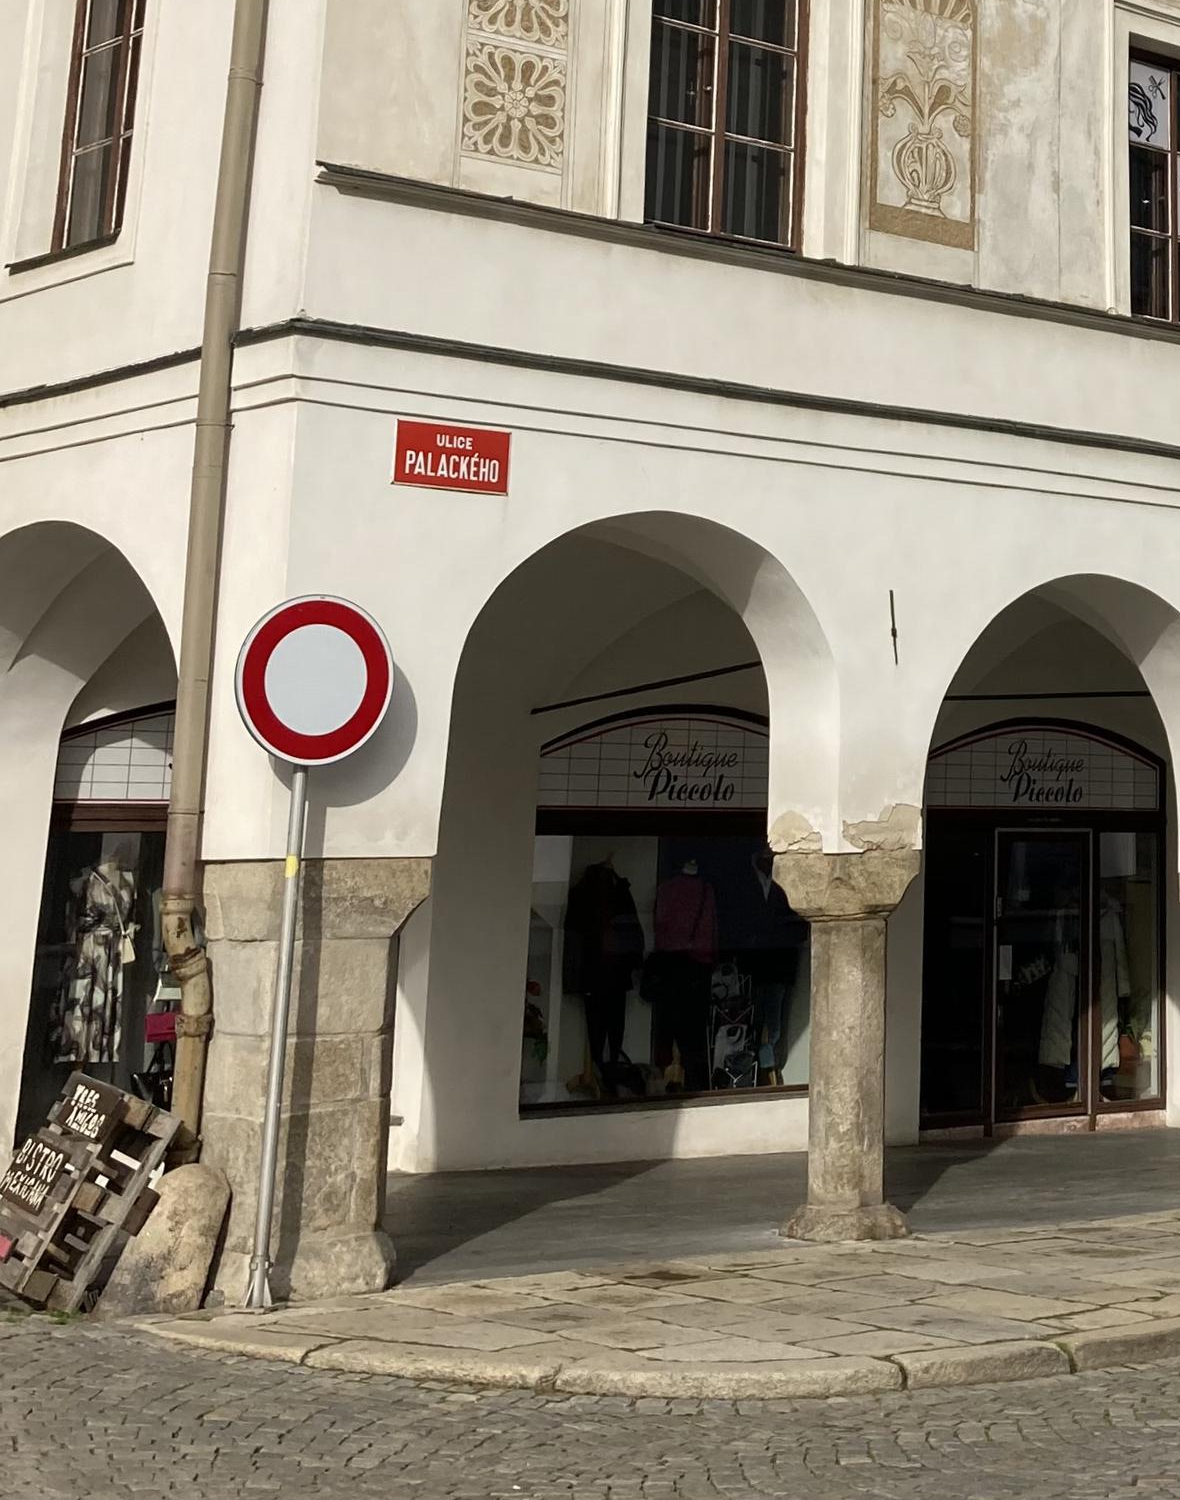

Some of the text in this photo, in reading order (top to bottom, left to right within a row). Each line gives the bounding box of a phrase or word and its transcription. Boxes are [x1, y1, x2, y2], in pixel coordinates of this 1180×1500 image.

[436, 433, 473, 450] ULICE
[404, 450, 499, 483] PALACKÉHO
[633, 731, 738, 778] Boutique
[1000, 740, 1085, 782] Boutique
[643, 767, 735, 801] Piccolo
[1008, 772, 1083, 803] Piccolo
[15, 1138, 64, 1183] BISTRO
